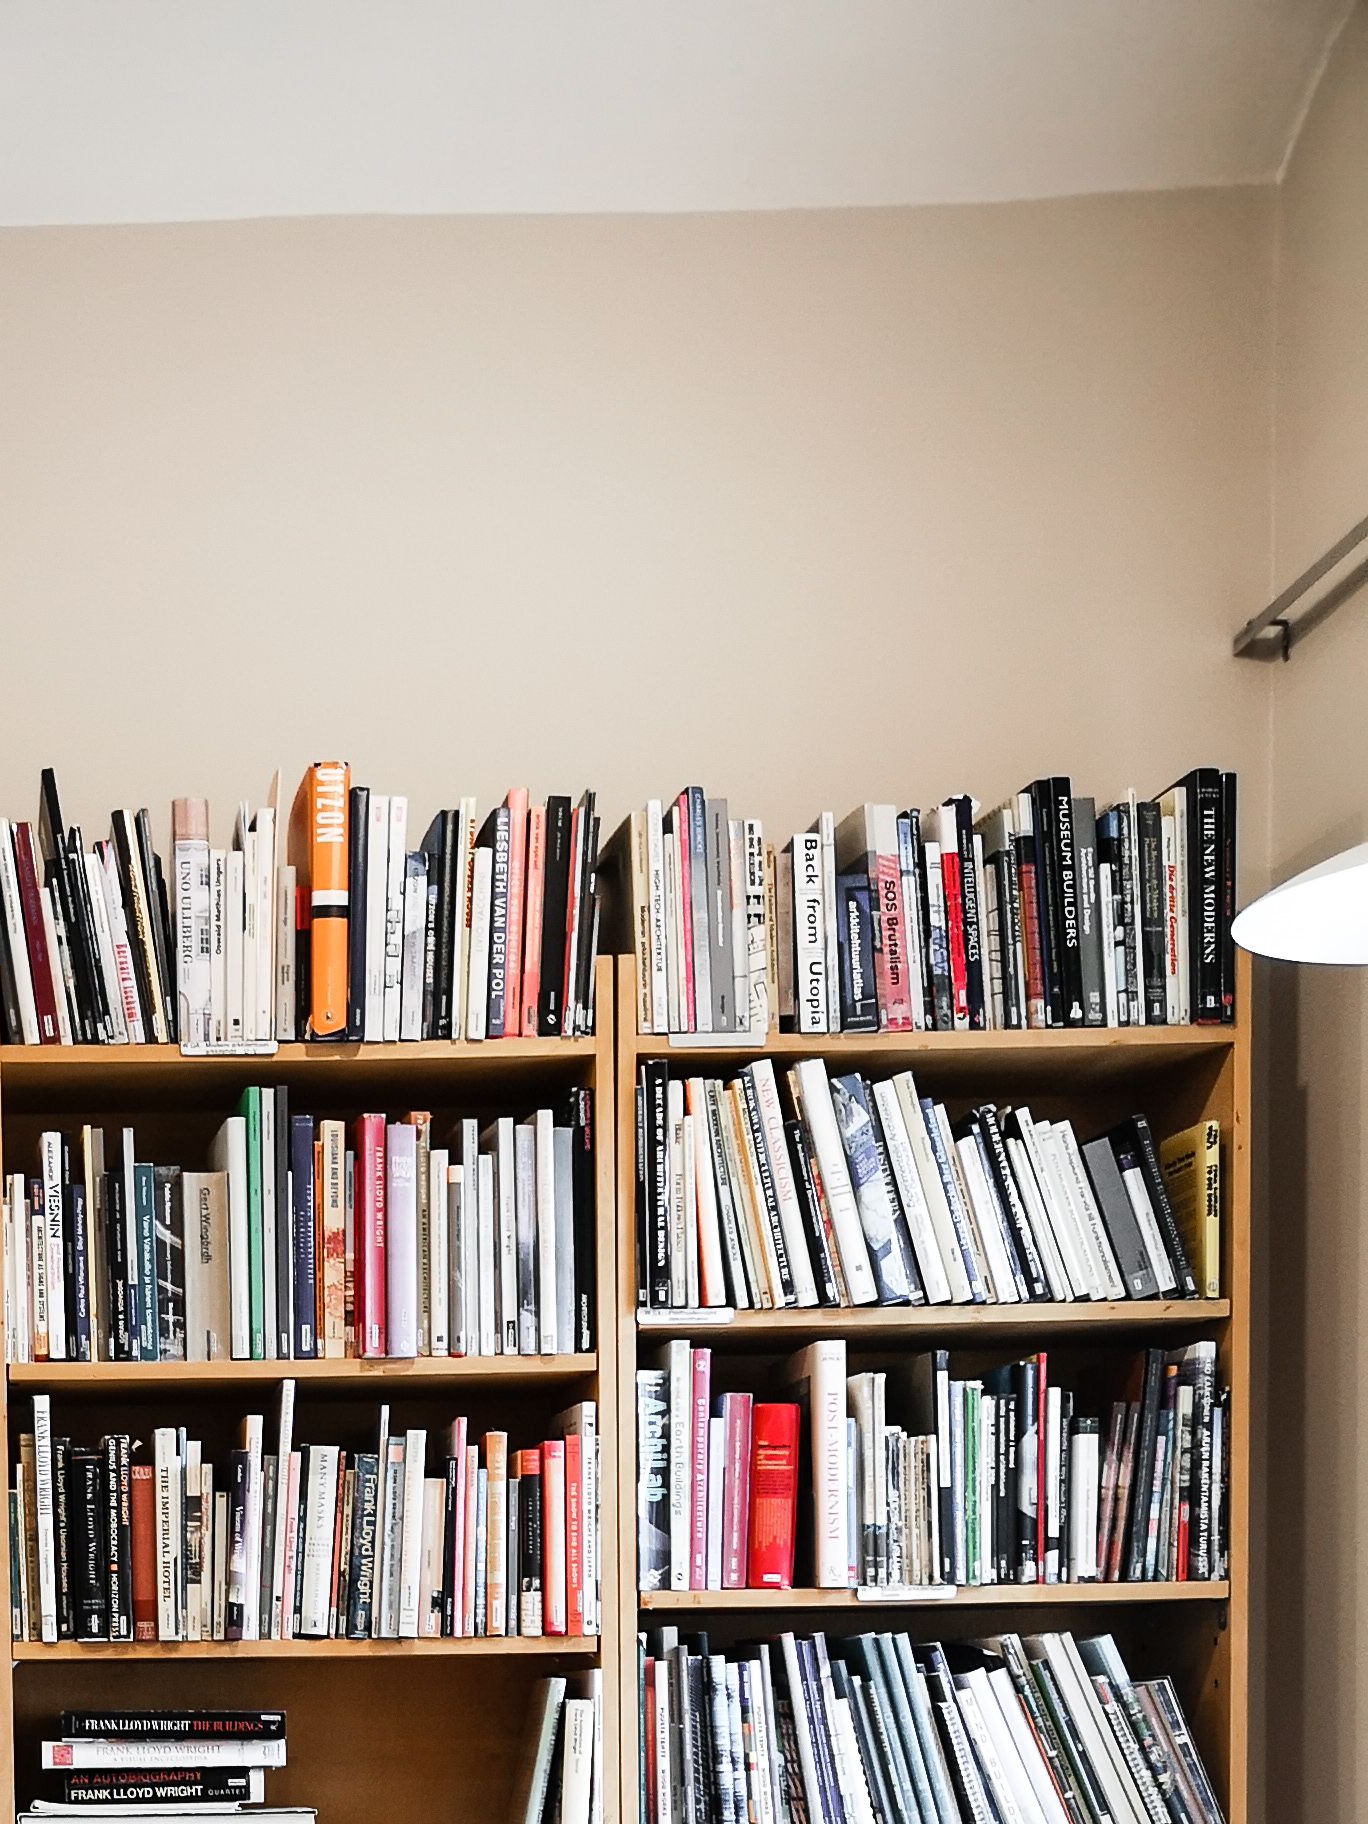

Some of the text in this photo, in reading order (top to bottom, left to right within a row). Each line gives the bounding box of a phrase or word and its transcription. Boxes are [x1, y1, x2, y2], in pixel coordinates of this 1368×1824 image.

[316, 767, 345, 843] UTZON
[180, 860, 193, 964] UNO ULLBERG
[491, 817, 508, 999] LIESBETH VAN DER POL
[964, 862, 980, 962] INTELLIGENT SPACES
[1058, 796, 1078, 948] MUSEUM BUILDERS
[1203, 807, 1216, 964] THE NEW MODERNS
[804, 838, 824, 1026] Back from Utopia
[848, 900, 864, 1000] arkkitehtuuriatlas
[884, 880, 902, 986] SOS Brutalism
[330, 1129, 338, 1208] LOUISIANA BEYOND
[758, 1077, 792, 1204] NEW CLASSICISM
[200, 1187, 212, 1264] Gert Wingårdh
[375, 1146, 384, 1248] FRANK LLOYD WRIGHT
[36, 1410, 51, 1516] FRANK LLOYD WRIGHT
[121, 1494, 130, 1526] WRIGHT
[316, 1454, 329, 1530] MANY MASKS
[671, 1421, 685, 1516] Earth Buildings
[826, 1392, 840, 1541] POST-MODERNISM
[85, 1464, 98, 1586] FRANK LLOYD WRIGHT
[160, 1467, 172, 1602] THE IMPERIAL HOTEL
[358, 1474, 378, 1604] Frank Lloyd Wright
[85, 1718, 191, 1731] FRANK LLOYD WRIGHT
[70, 1786, 203, 1801] FRANK LLOYD WRIGHT
